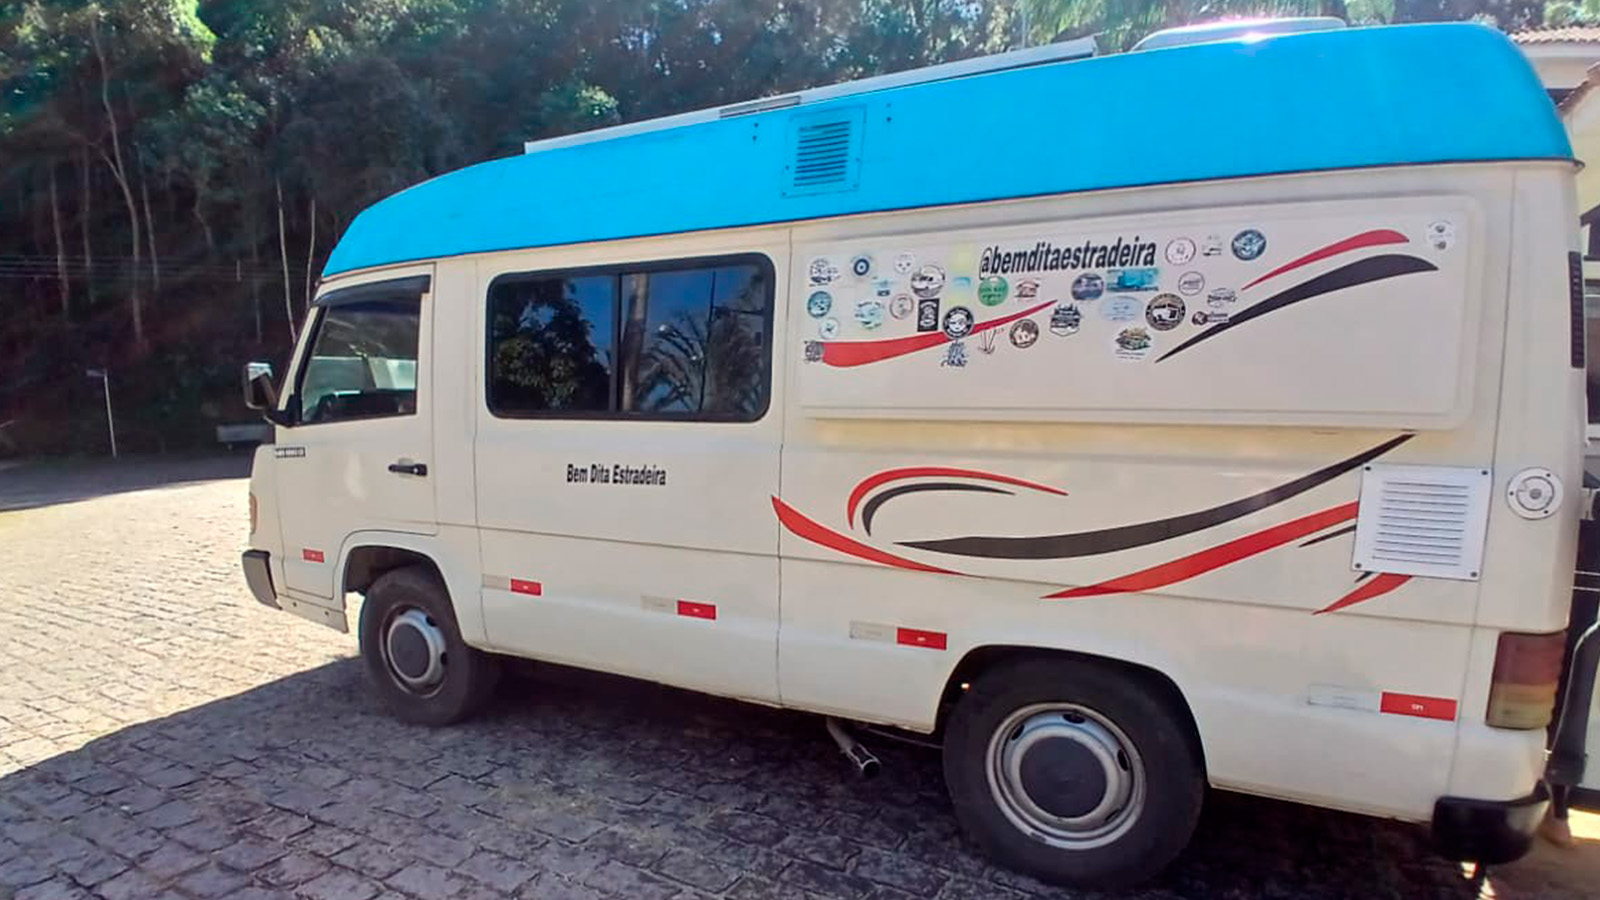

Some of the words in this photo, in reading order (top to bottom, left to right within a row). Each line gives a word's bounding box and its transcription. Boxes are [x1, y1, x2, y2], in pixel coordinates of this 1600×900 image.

[979, 236, 1157, 280] @bemditaestradeira
[567, 463, 588, 483] Bem
[590, 463, 610, 484] Dita
[612, 463, 666, 486] Estradeira
